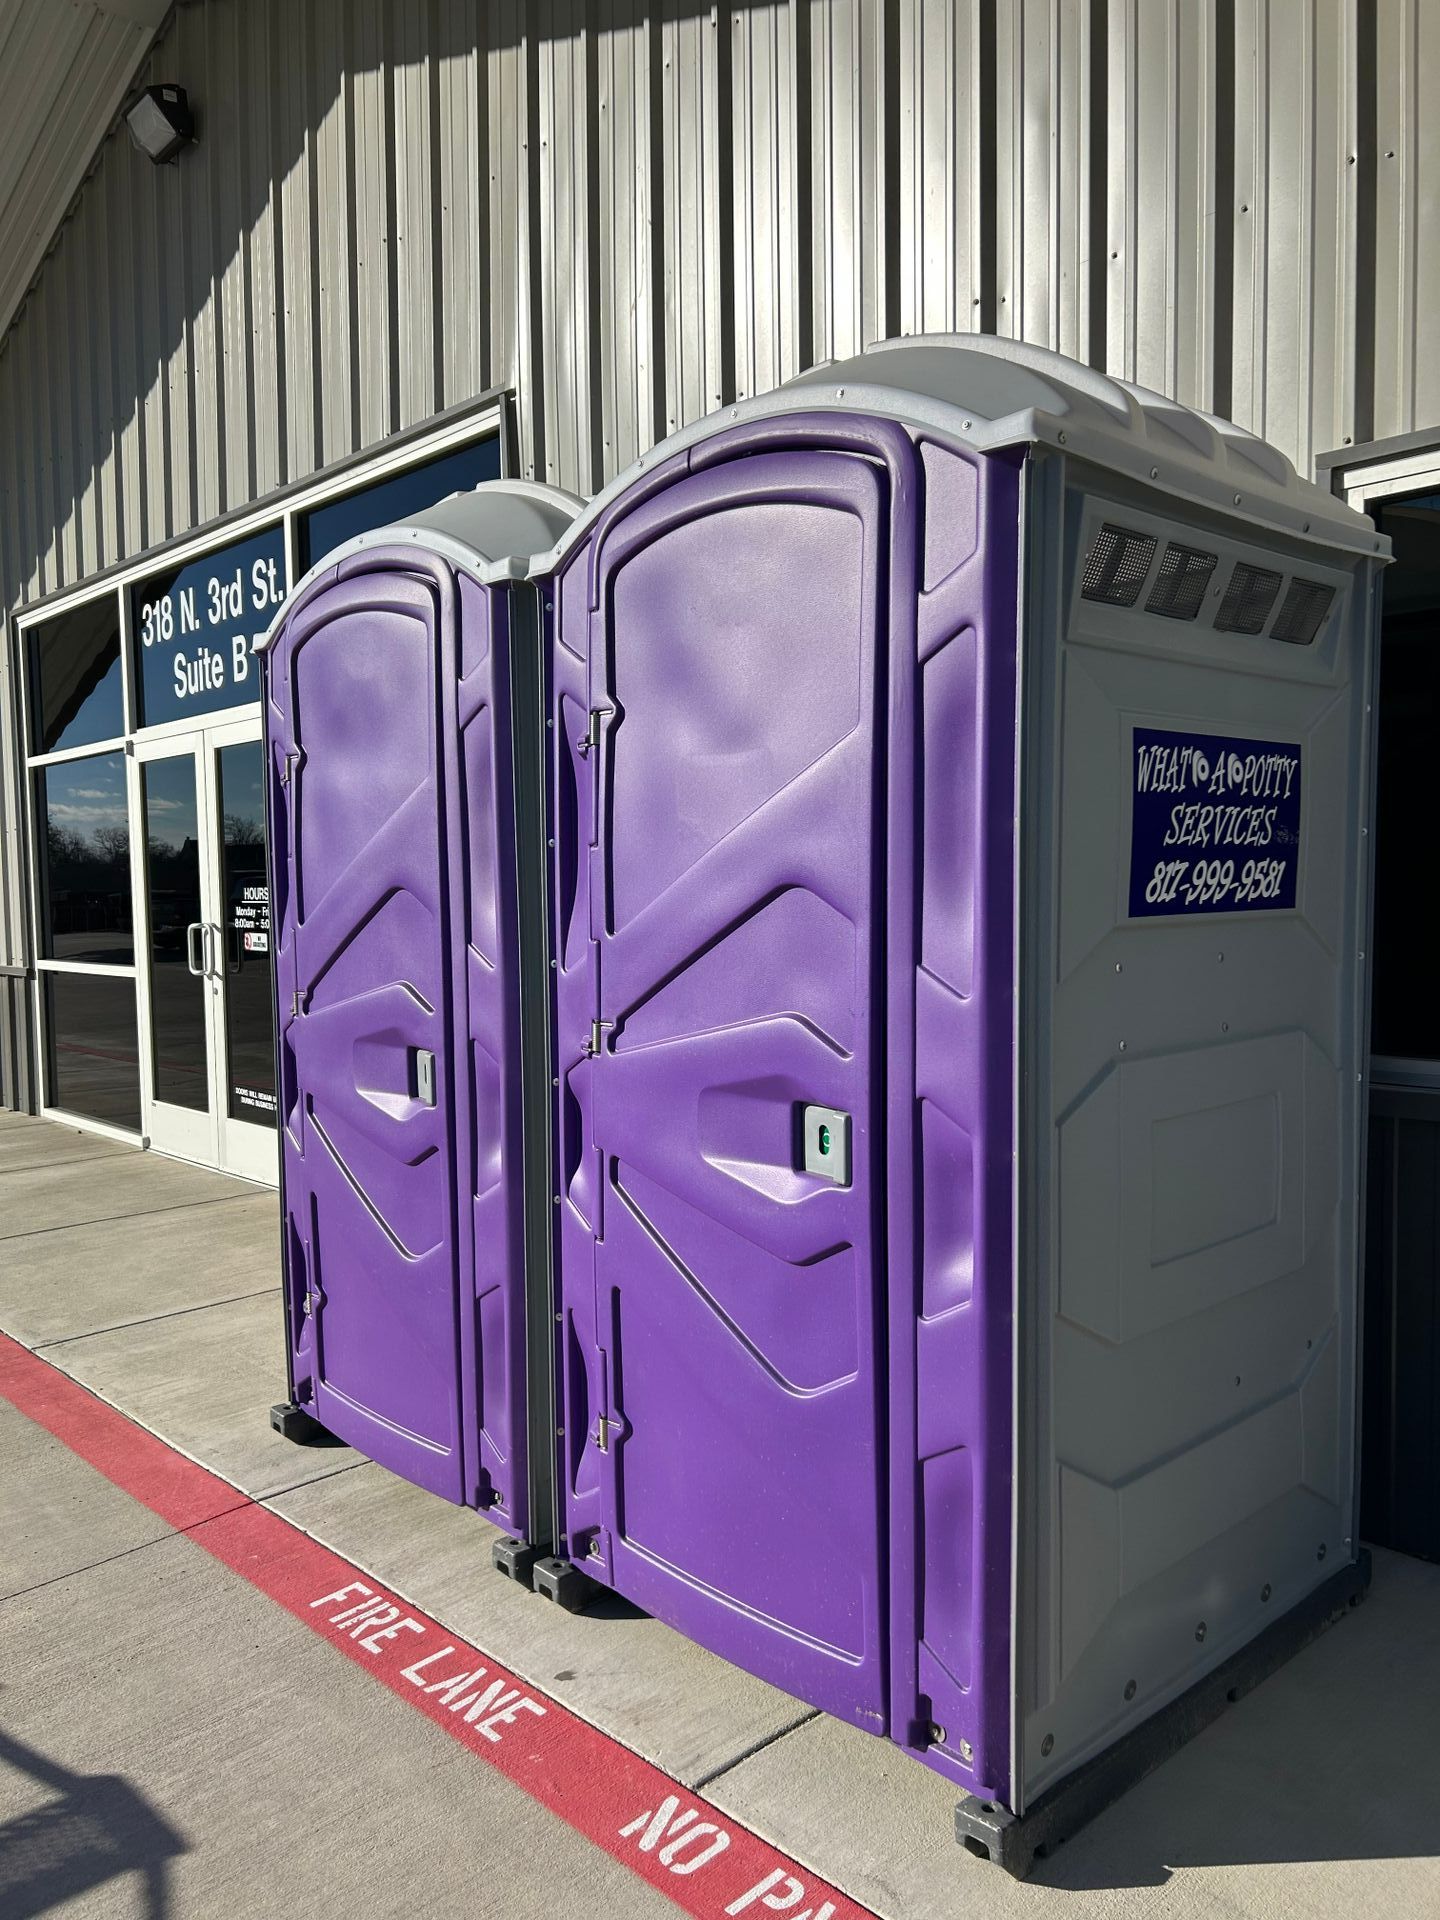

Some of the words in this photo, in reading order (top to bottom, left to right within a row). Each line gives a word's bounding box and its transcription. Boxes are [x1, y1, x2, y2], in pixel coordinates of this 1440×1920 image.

[142, 595, 174, 647] 318
[180, 587, 200, 634] N.
[208, 568, 243, 625] 3rd
[252, 558, 284, 610] St.
[174, 647, 224, 698] Suite
[1137, 745, 1194, 793] WHAT
[1208, 751, 1226, 795] A
[1240, 754, 1298, 799] POTTY
[1163, 802, 1278, 848] SERVICES
[244, 887, 269, 900] HOURS
[1145, 857, 1286, 905] 817-999-9581
[236, 906, 256, 917] Monday
[310, 1581, 426, 1655] FIRE
[400, 1645, 548, 1743] LANE
[618, 1794, 731, 1875] NO
